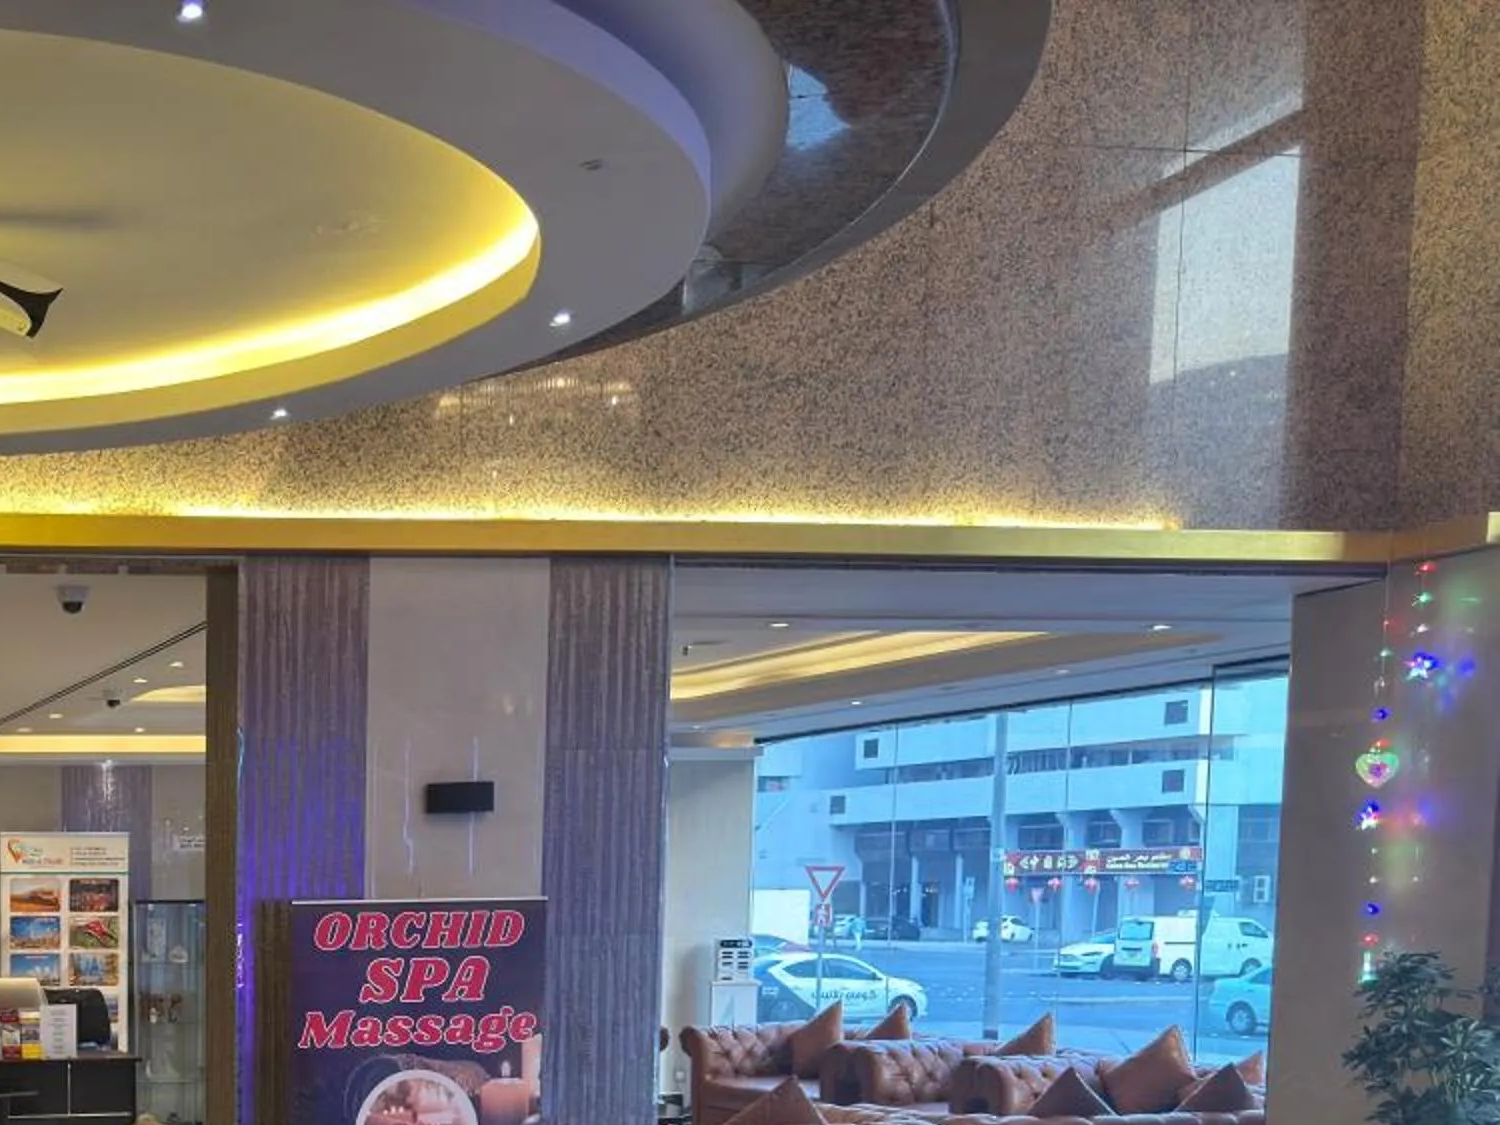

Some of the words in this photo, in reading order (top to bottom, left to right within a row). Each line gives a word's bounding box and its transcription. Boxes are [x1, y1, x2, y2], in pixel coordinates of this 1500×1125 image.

[313, 910, 526, 951] ORCHID
[358, 955, 491, 1004] SPA
[297, 1005, 537, 1054] Massage
